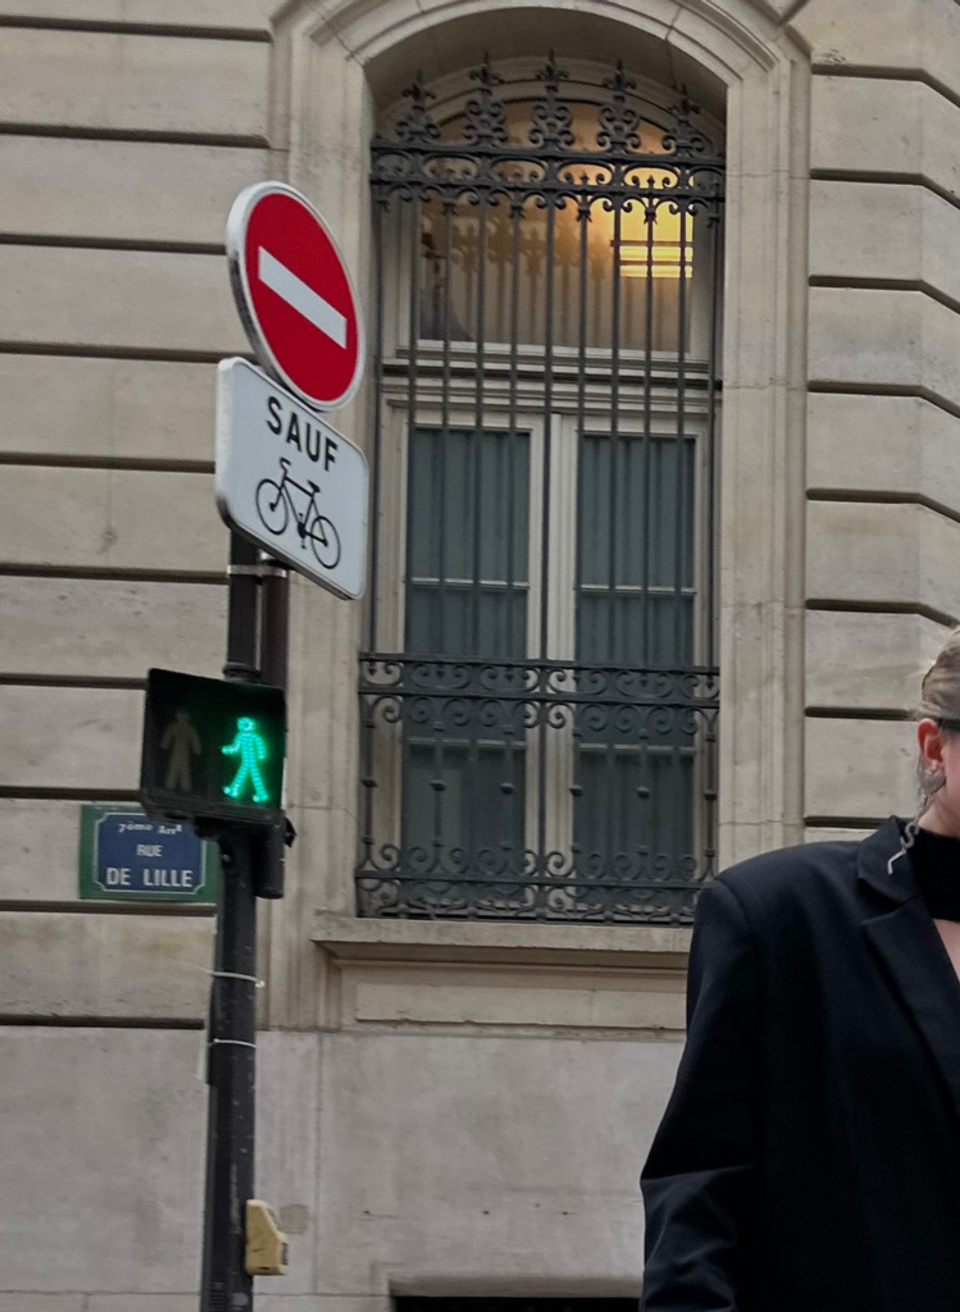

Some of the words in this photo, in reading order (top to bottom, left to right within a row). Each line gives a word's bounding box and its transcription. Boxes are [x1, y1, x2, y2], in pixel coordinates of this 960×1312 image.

[265, 395, 338, 472] SAUF
[136, 843, 162, 857] RUE
[106, 867, 131, 886] DE
[143, 868, 193, 888] LILLE
